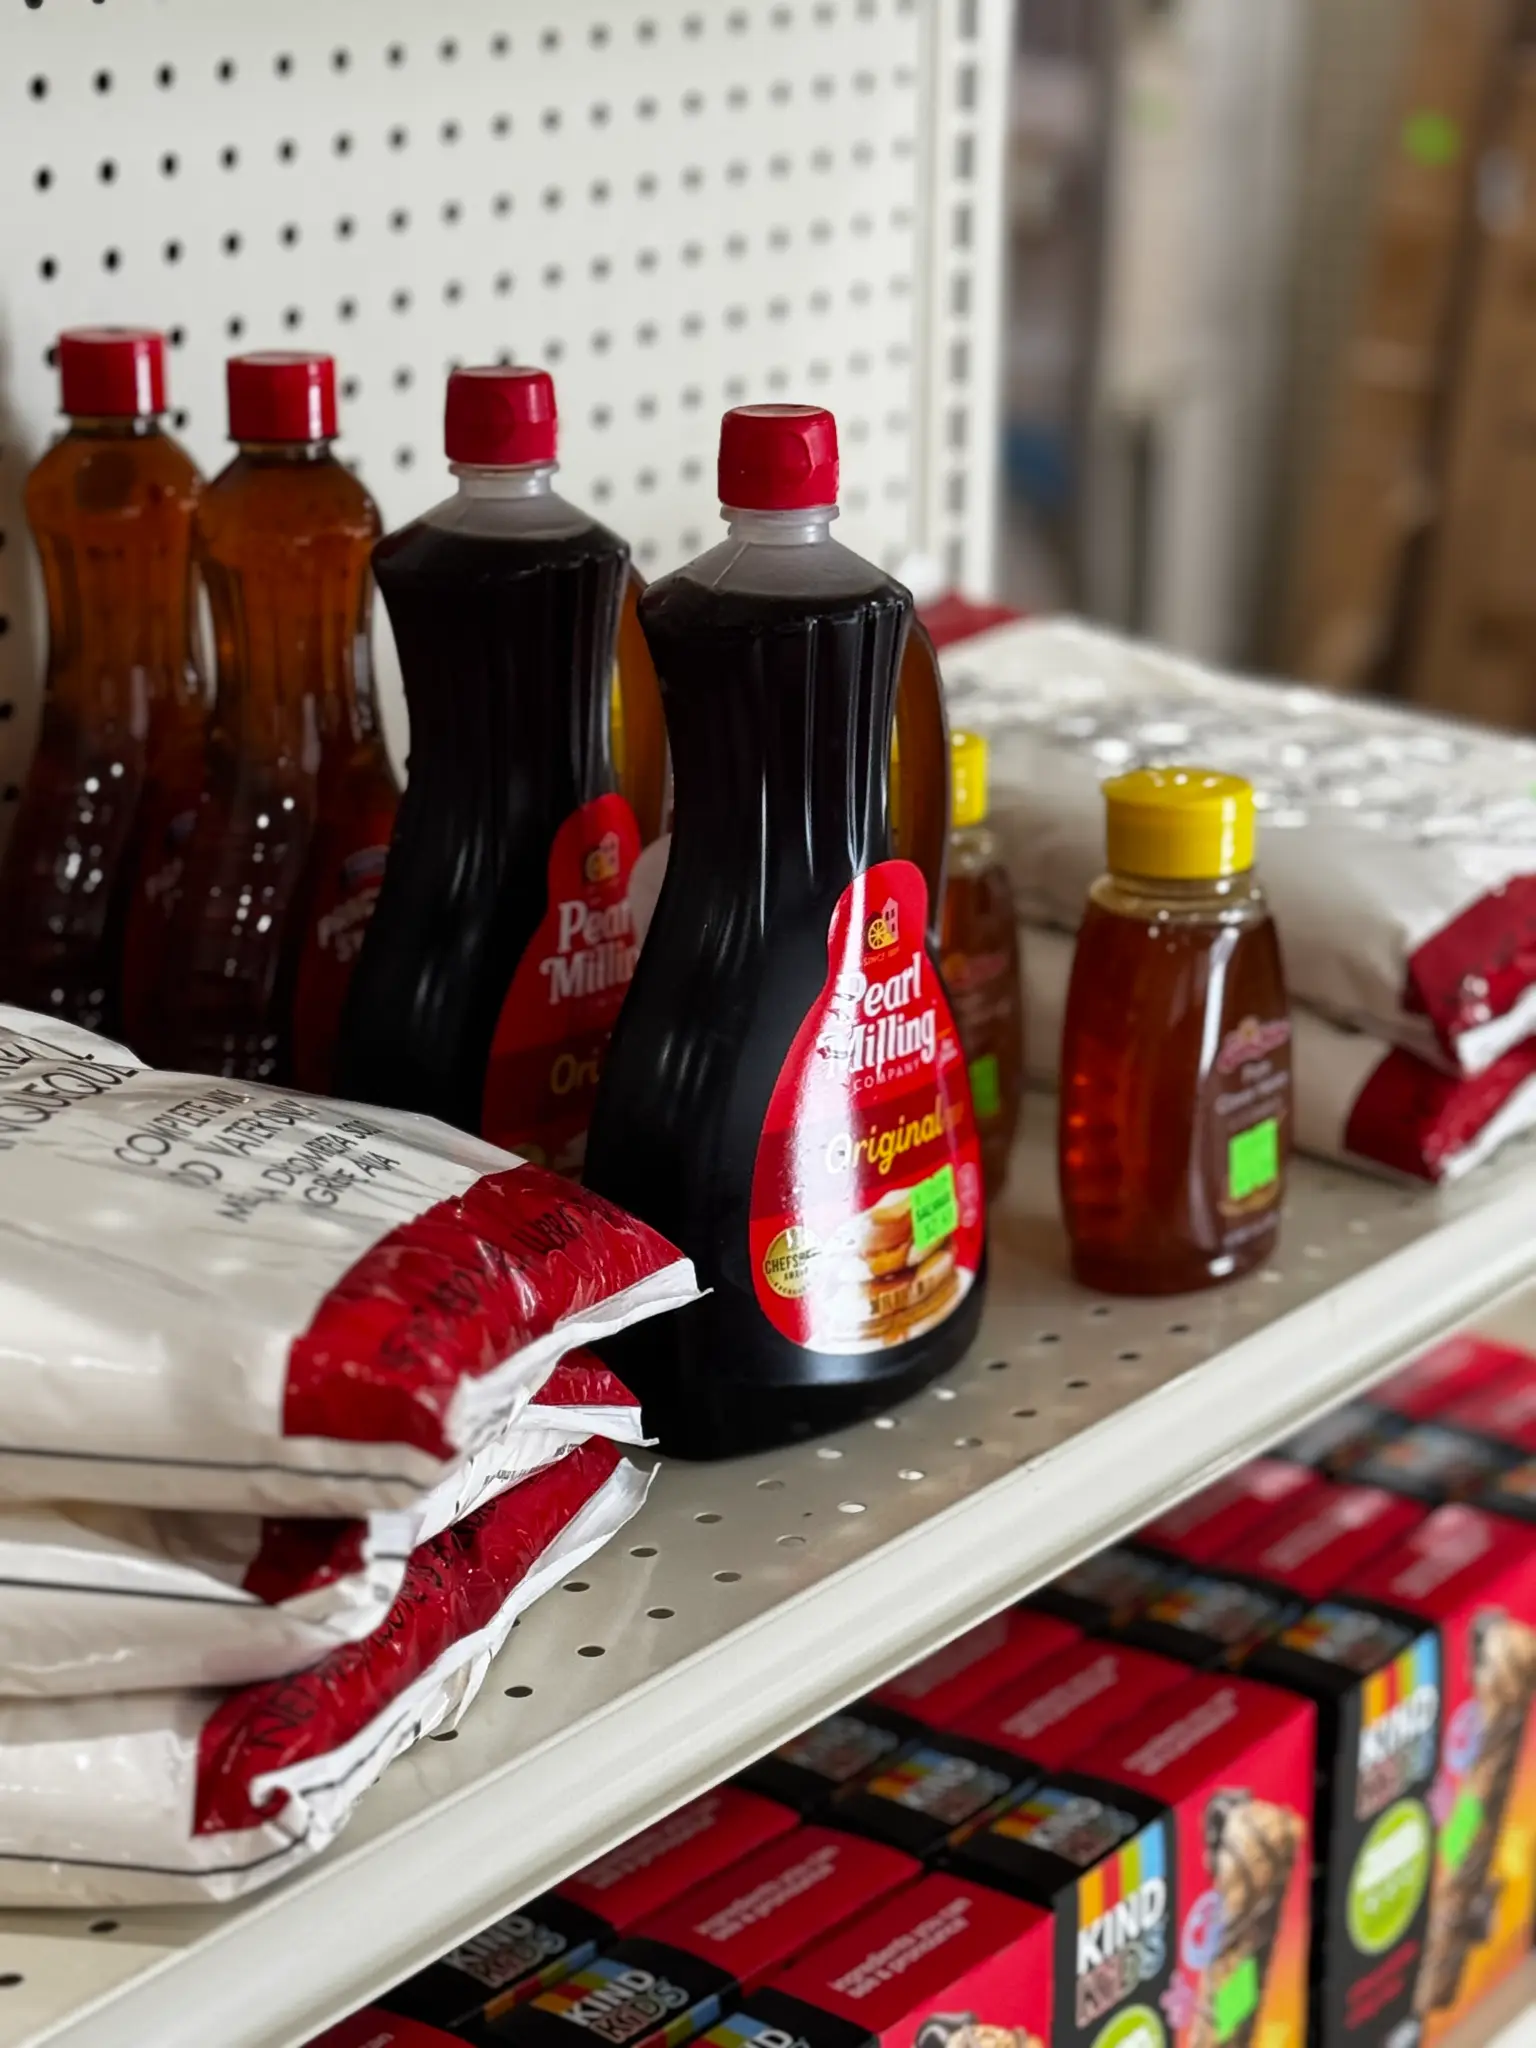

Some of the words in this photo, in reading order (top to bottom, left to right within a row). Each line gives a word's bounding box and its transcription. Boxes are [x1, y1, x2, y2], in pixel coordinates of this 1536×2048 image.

[836, 951, 922, 1018] Pearl
[815, 1008, 937, 1078] Milling
[852, 1058, 921, 1093] COMPANY
[825, 1093, 947, 1175] Original
[1077, 1877, 1167, 1977] KIND
[560, 1967, 656, 2028] KIND
[588, 1975, 691, 2044] KIDS
